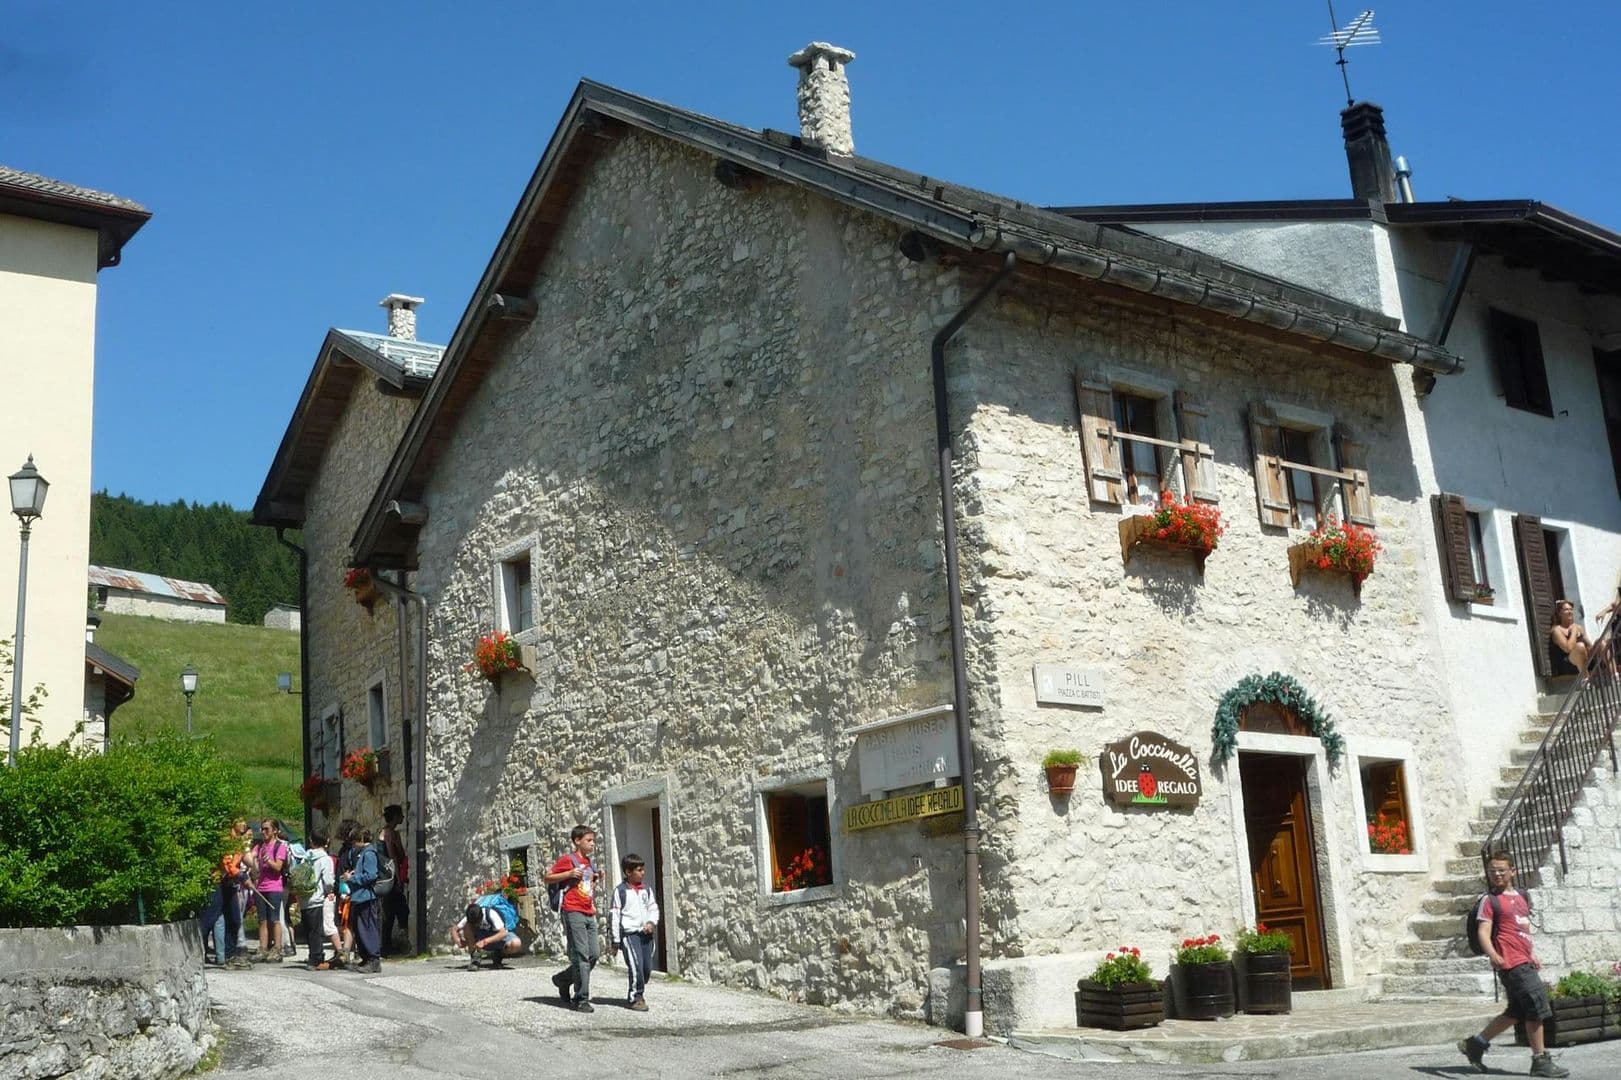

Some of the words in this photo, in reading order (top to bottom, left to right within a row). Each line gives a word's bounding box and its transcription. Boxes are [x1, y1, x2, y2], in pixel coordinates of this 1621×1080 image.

[1065, 672, 1090, 687] PILL
[864, 731, 896, 749] CASA
[907, 718, 946, 737] MUSEO
[1109, 751, 1128, 779] La
[1130, 736, 1197, 779] Coccinella
[1115, 779, 1138, 793] IDEE
[1157, 781, 1197, 794] REGALO
[907, 795, 926, 817] IDEE
[927, 787, 960, 813] REGALO
